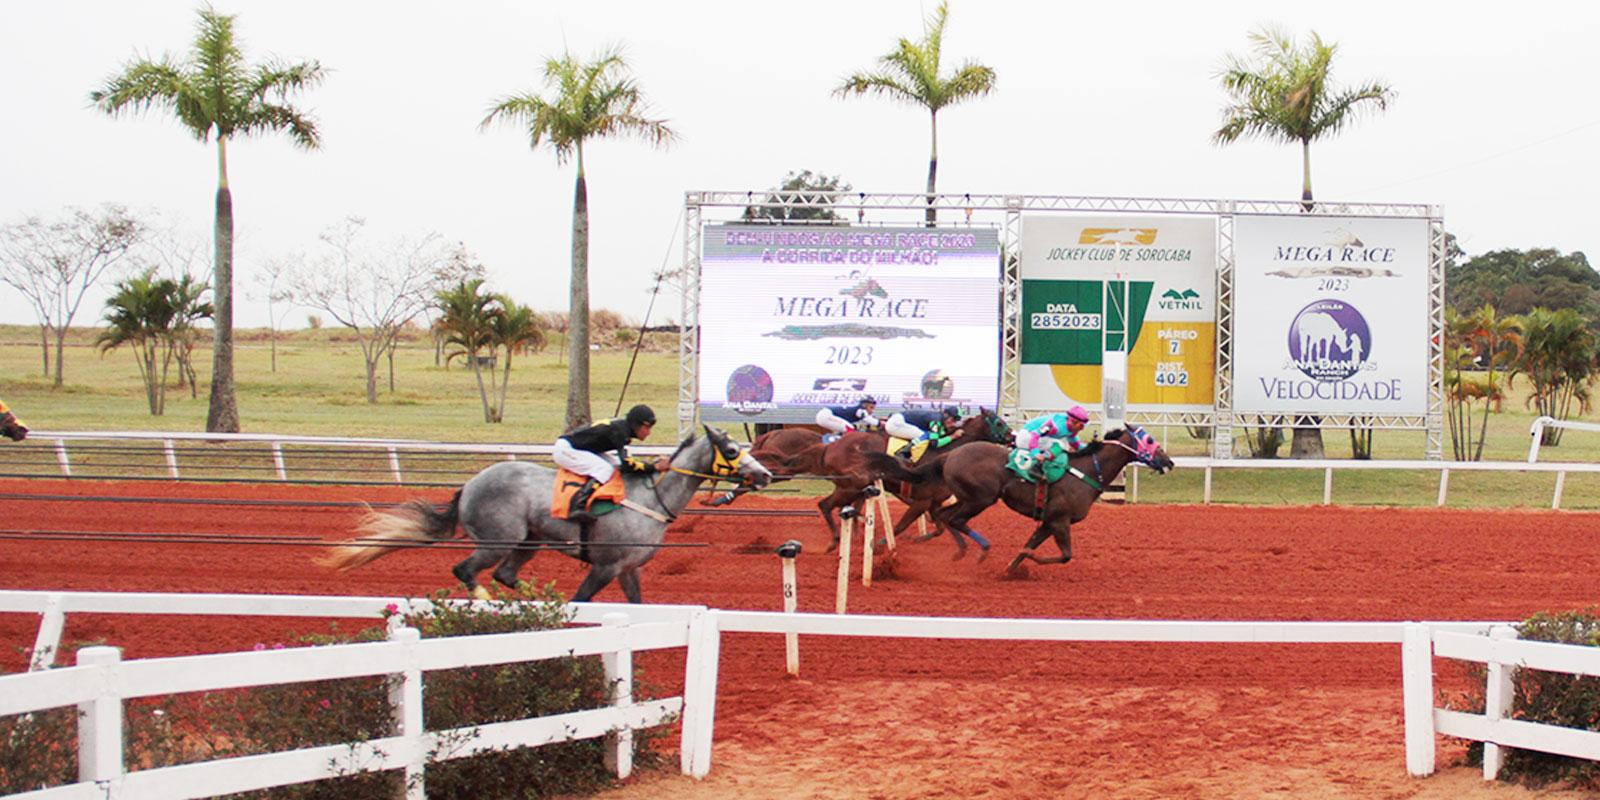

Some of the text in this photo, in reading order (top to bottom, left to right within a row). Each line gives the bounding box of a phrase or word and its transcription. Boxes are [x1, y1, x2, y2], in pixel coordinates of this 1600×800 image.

[847, 232, 892, 247] MEGA
[896, 233, 938, 248] RACE
[940, 233, 976, 248] 2023
[761, 248, 773, 264] A
[776, 248, 845, 264] CORRIDA
[848, 249, 871, 265] DO
[1046, 248, 1086, 261] JOCKEY
[1088, 249, 1115, 261] CLUB
[1136, 249, 1192, 262] SOROCABA
[1274, 246, 1396, 263] MEGA RACE
[1318, 278, 1350, 291] 2023
[773, 297, 929, 318] MEGA RACE
[1047, 304, 1078, 313] DATA
[1159, 302, 1203, 310] VETNIL
[1032, 315, 1100, 328] 2852023
[1157, 328, 1198, 340] PÁREO
[1171, 342, 1179, 353] 7
[825, 346, 874, 365] 2023
[1157, 363, 1185, 372] DIST.
[1283, 359, 1378, 371] ANA DANTAS
[1157, 373, 1188, 385] 402
[1260, 378, 1402, 401] VELOCIDADE
